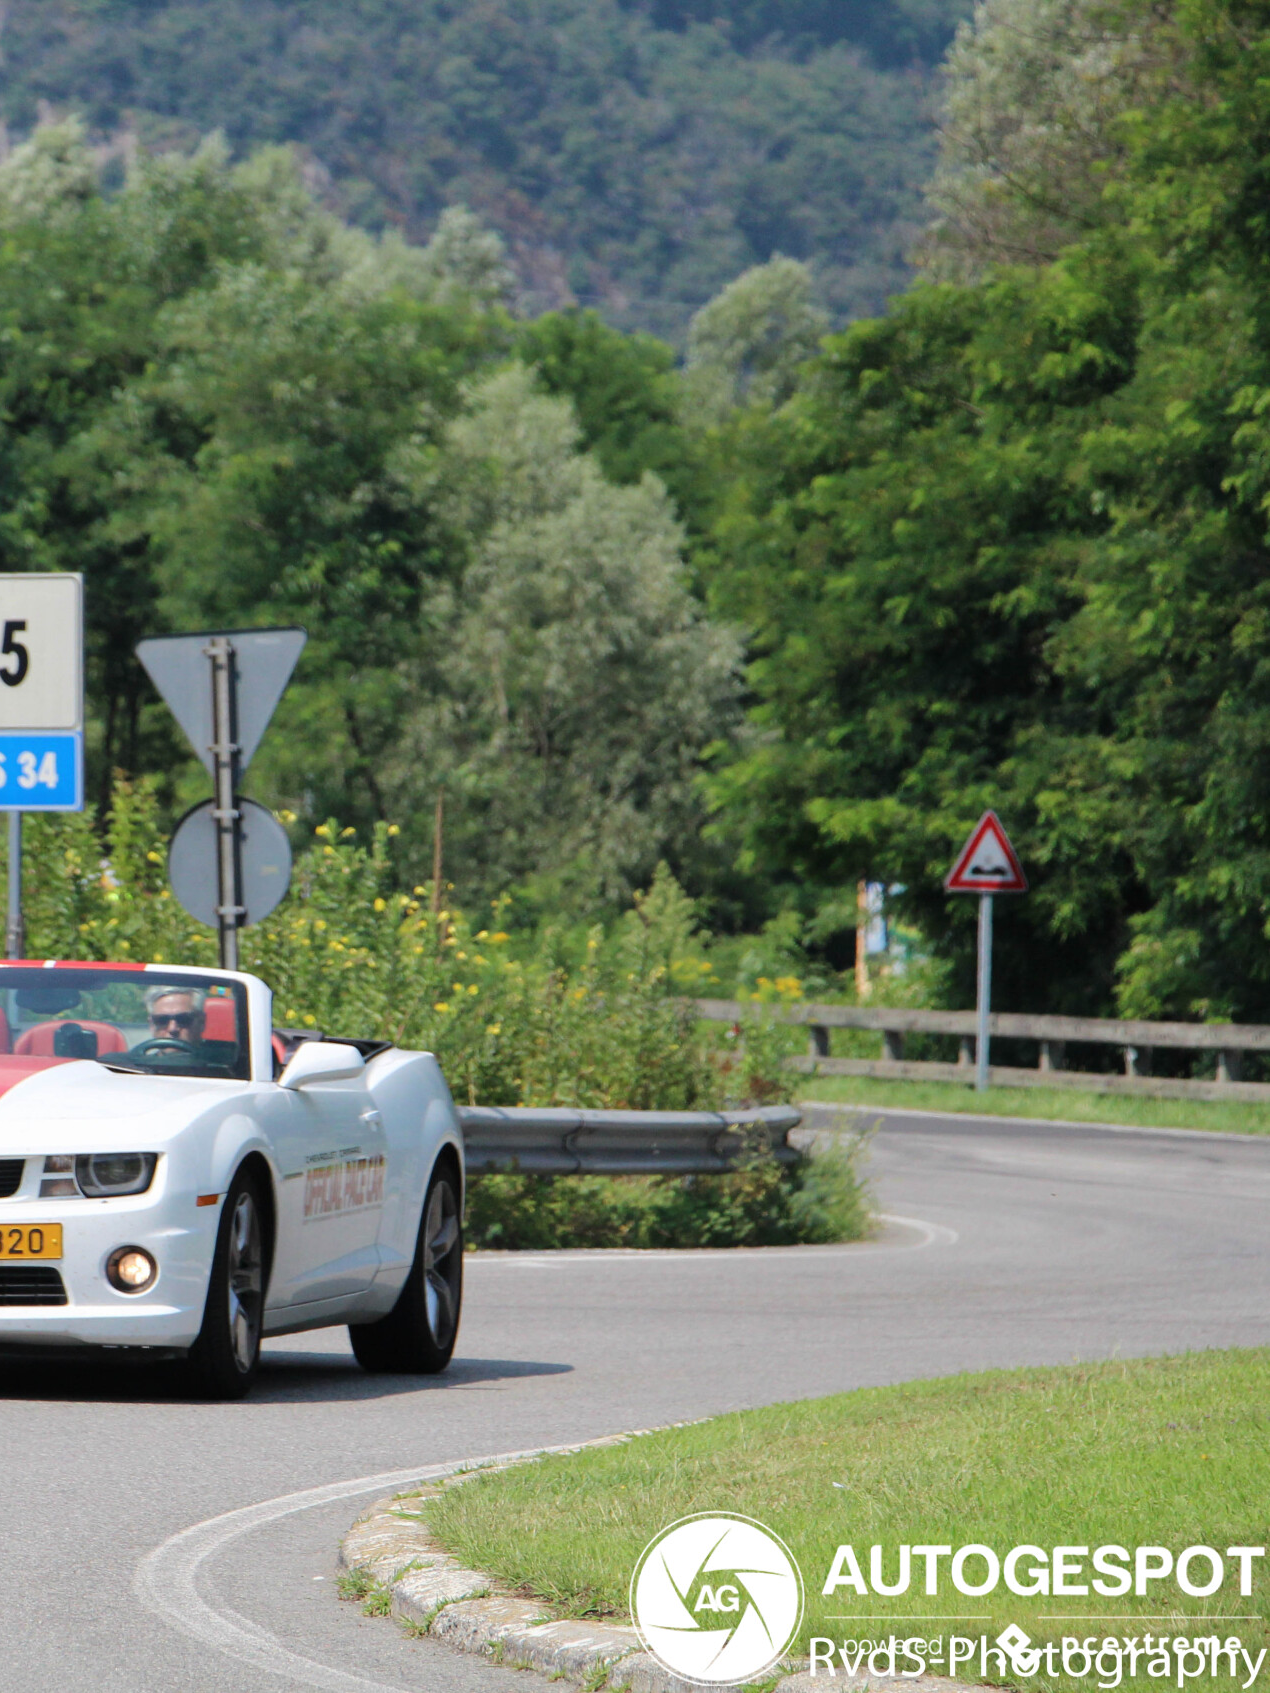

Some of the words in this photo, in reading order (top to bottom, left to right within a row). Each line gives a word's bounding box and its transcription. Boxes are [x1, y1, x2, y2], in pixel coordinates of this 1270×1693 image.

[17, 751, 58, 789] 34
[304, 1162, 343, 1217] OFFICIAL
[344, 1157, 367, 1209] PACE
[365, 1153, 386, 1204] CAR
